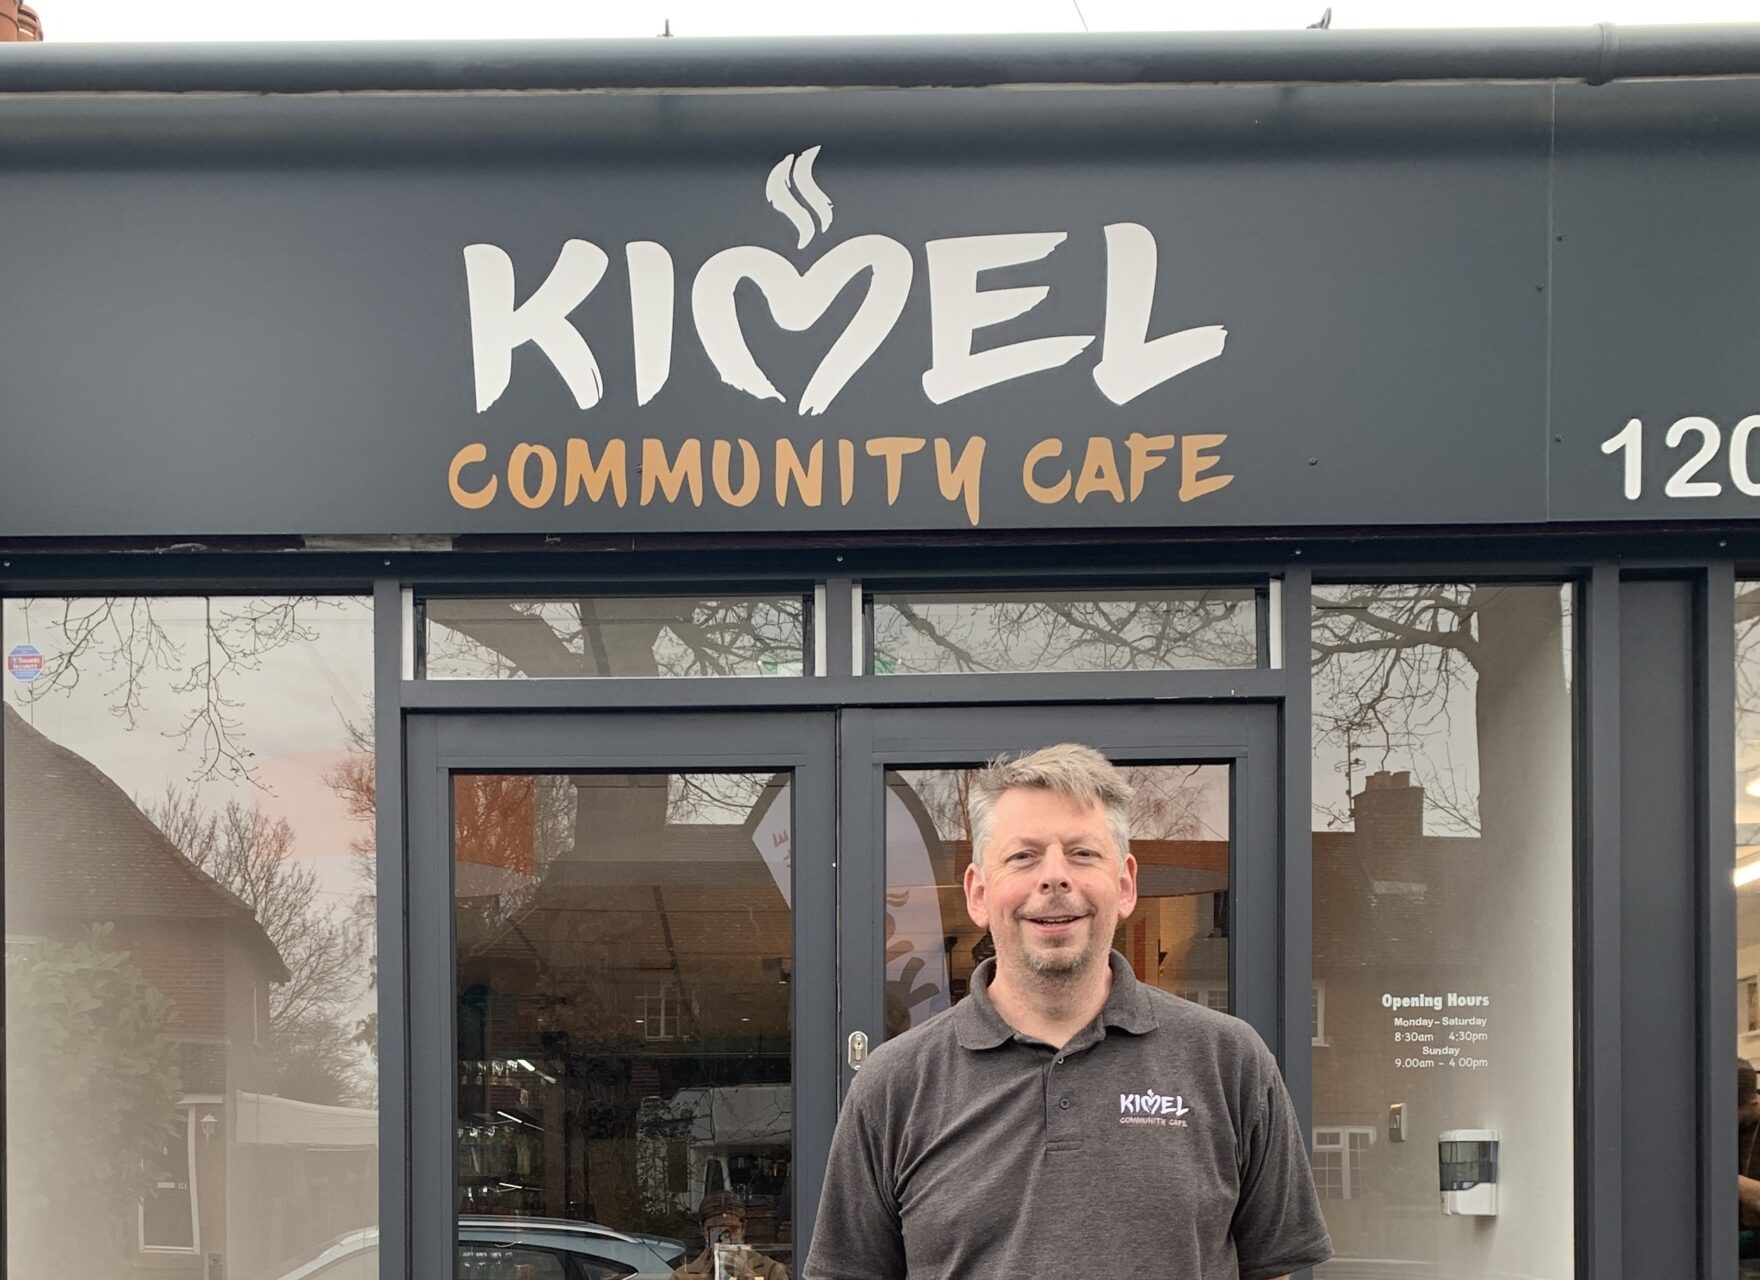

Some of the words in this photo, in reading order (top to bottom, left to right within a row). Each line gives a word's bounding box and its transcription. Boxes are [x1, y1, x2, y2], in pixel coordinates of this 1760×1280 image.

[464, 223, 1228, 414] KIMEL
[448, 436, 986, 526] COMMUNITY
[1023, 433, 1235, 505] CAFE
[1381, 993, 1443, 1011] Opening
[1447, 993, 1490, 1007] Hours
[1422, 1046, 1460, 1057] Sunday
[1120, 1093, 1189, 1116] KIMEL
[1119, 1116, 1165, 1126] COMMUNITY
